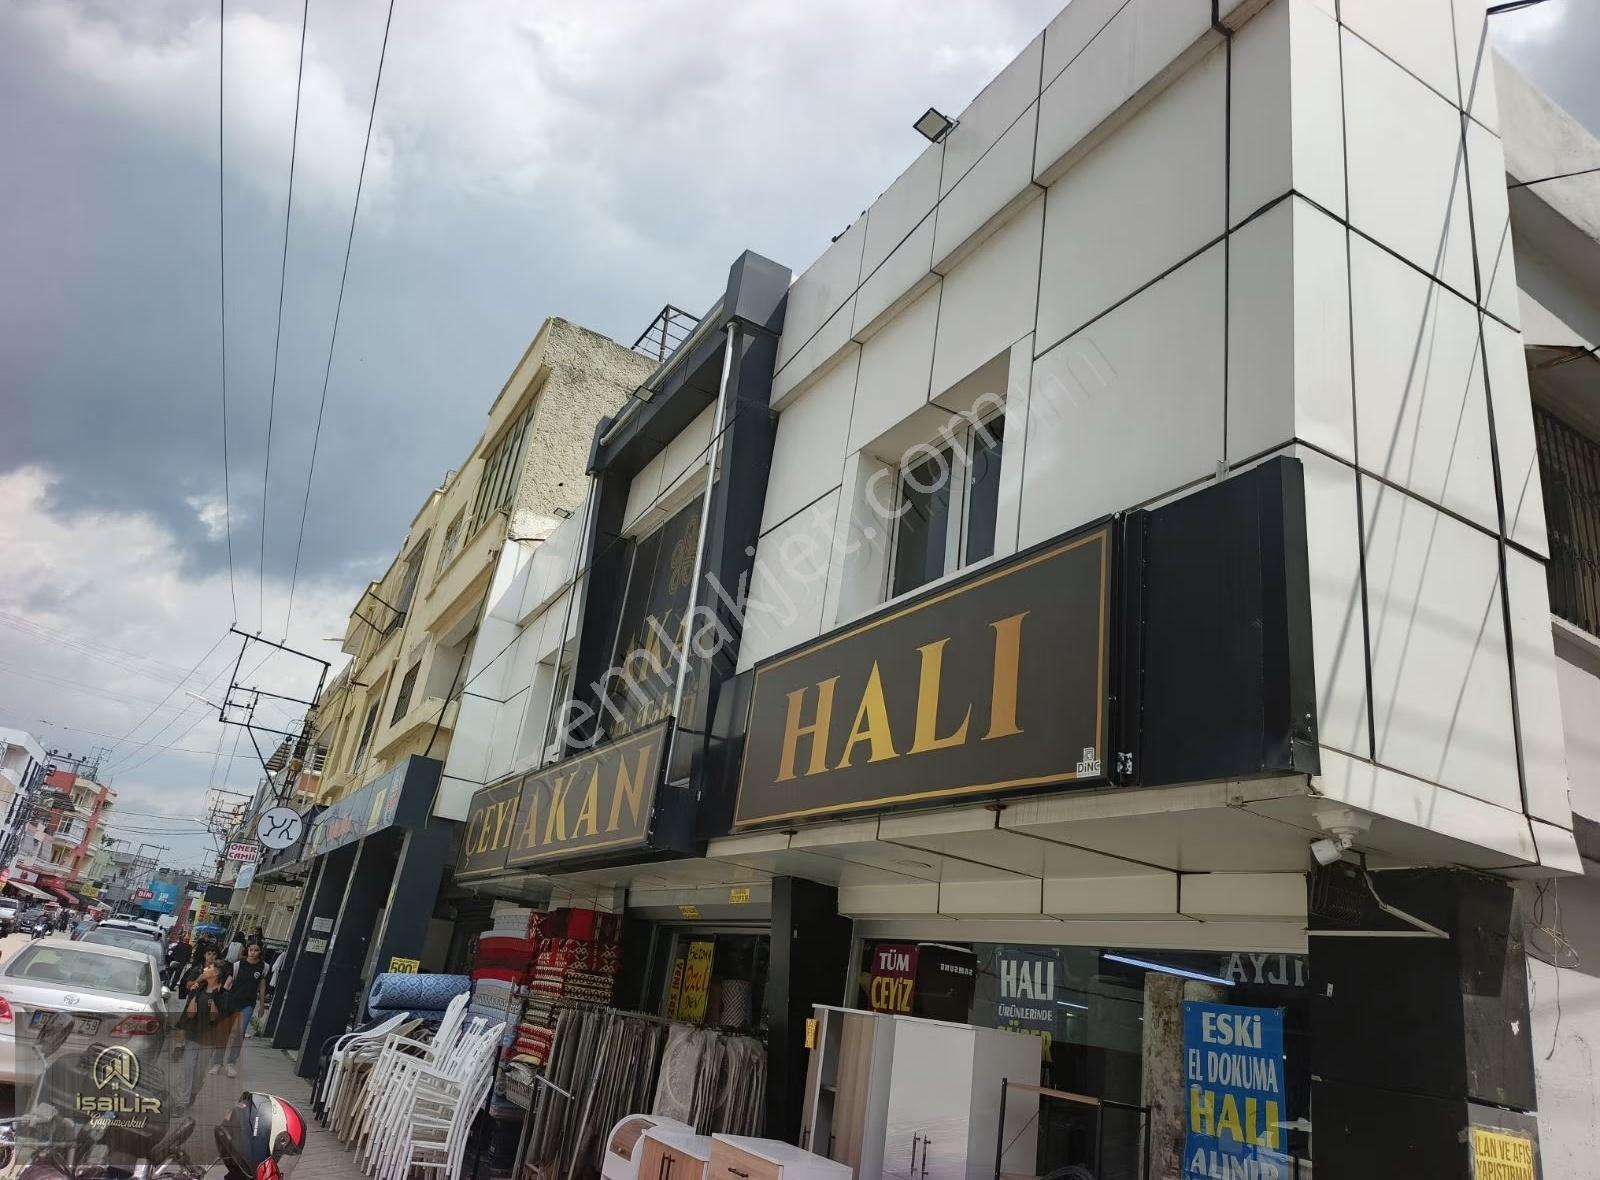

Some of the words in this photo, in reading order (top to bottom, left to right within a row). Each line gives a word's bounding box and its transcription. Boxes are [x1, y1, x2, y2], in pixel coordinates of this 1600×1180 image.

[774, 611, 1031, 782] HALI
[517, 744, 653, 850] AKAN
[390, 962, 413, 974] 500
[879, 949, 910, 972] TÜM
[1000, 959, 1055, 1001] HALI
[998, 1003, 1053, 1021] ÜRÜNLERİNDE
[1202, 1012, 1262, 1048] ESKİ
[1188, 1048, 1203, 1081] EL
[1208, 1051, 1278, 1093] DOKUMA
[1191, 1086, 1280, 1149] HALI
[1499, 1140, 1511, 1161] VE
